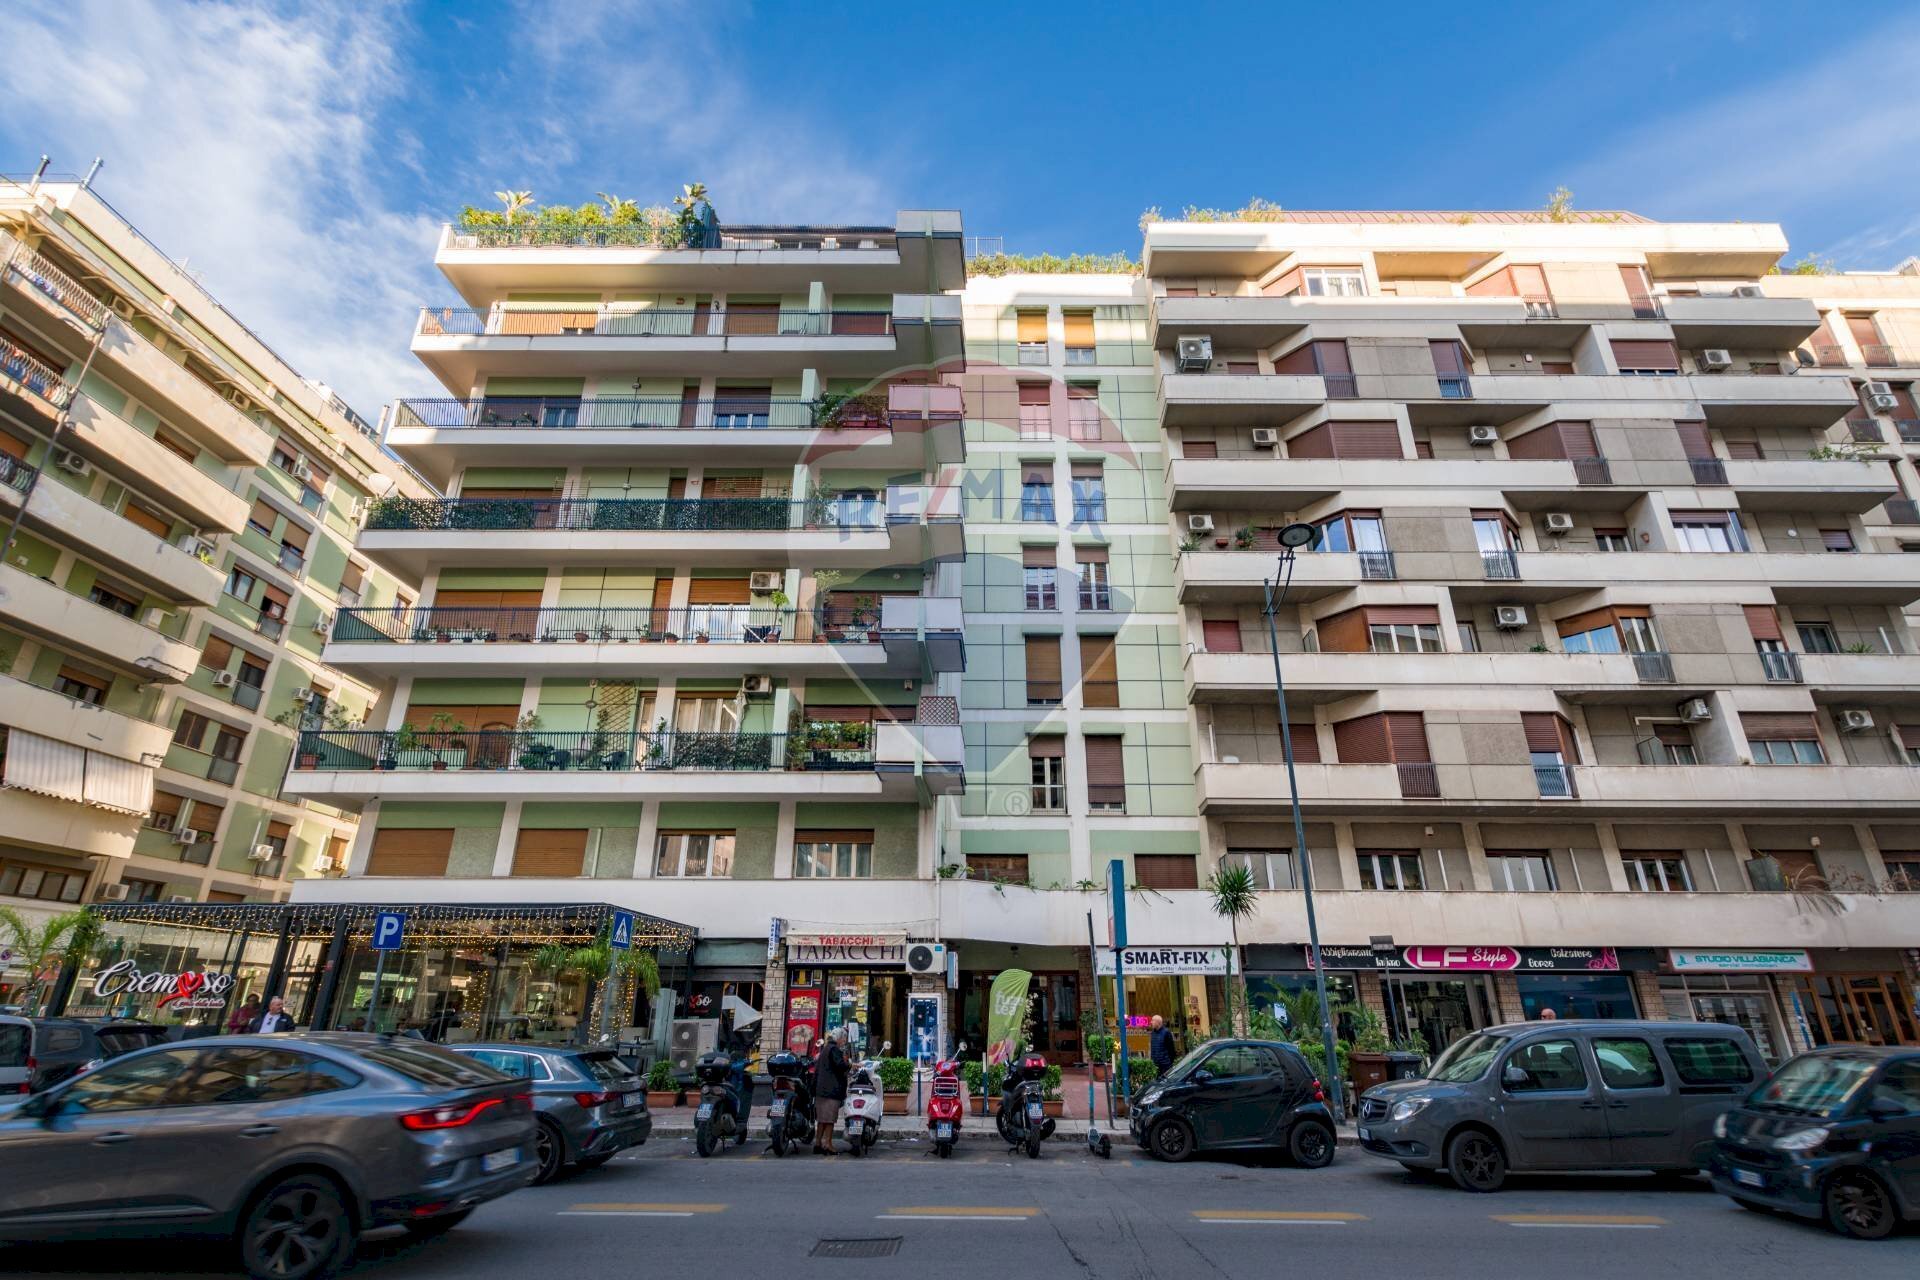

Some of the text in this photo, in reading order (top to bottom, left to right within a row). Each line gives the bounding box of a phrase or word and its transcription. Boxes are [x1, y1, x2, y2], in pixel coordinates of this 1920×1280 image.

[379, 916, 399, 945] P
[818, 935, 874, 945] TABACCHI
[796, 945, 905, 960] TABACCHI
[1124, 951, 1210, 965] SMART-FIX
[1417, 947, 1507, 967] LF Style
[1695, 955, 1797, 963] STUDIO VILLABIANCA
[1528, 958, 1555, 968] Borse
